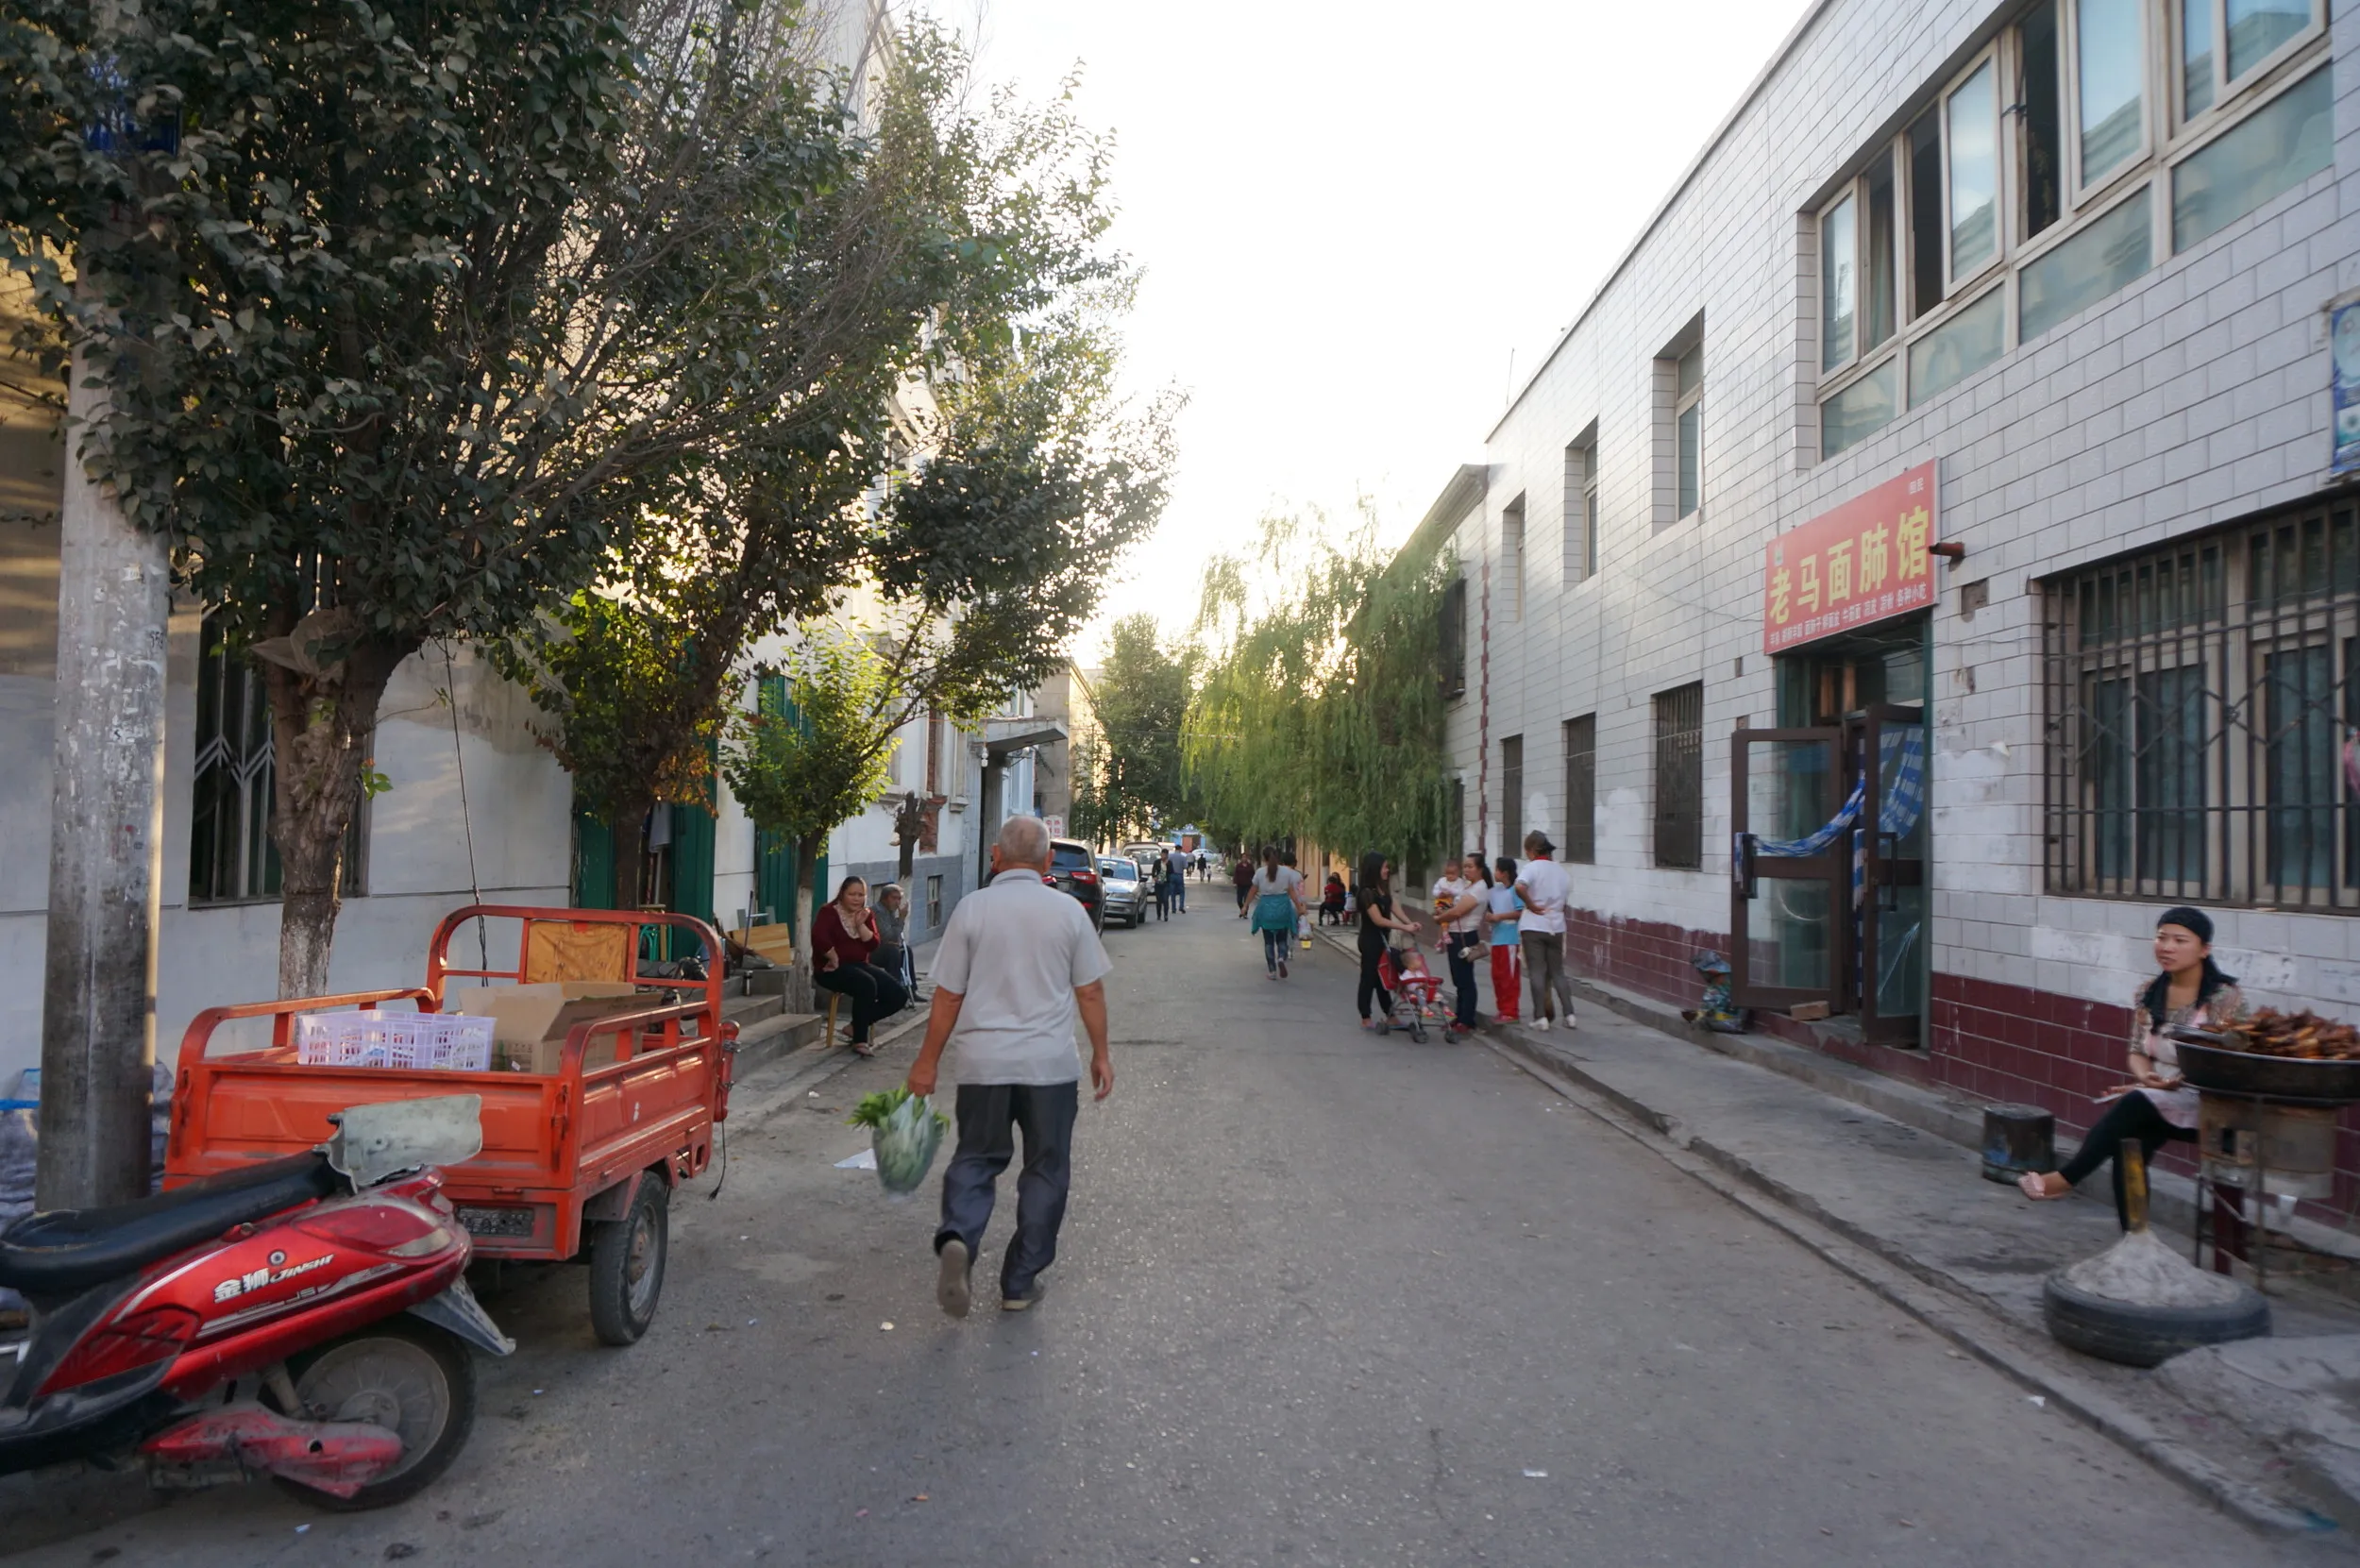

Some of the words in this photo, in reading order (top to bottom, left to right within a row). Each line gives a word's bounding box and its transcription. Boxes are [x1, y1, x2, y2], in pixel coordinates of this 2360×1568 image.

[1769, 505, 1929, 625] 老马面肺馆
